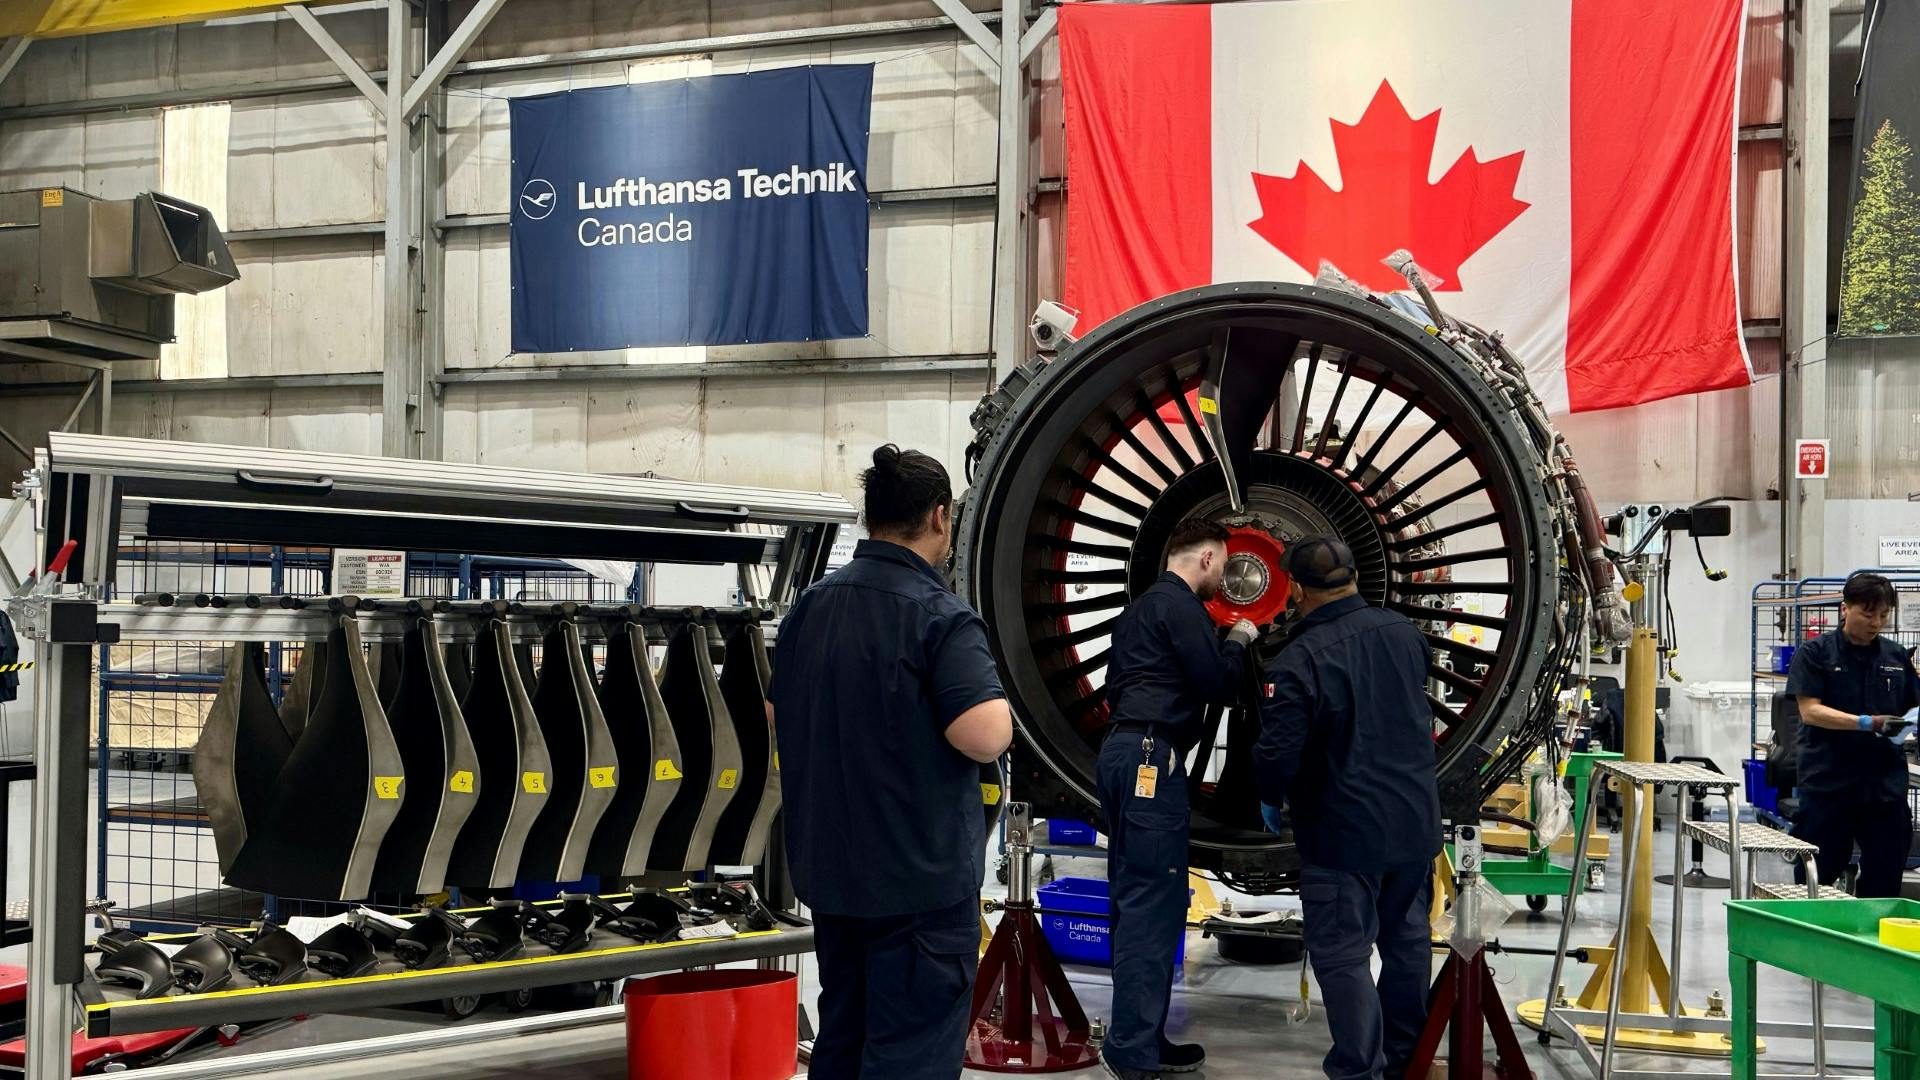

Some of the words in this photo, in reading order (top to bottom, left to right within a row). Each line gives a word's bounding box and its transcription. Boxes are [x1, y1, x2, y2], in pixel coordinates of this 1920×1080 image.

[578, 177, 731, 210] Lufthansa
[737, 162, 857, 199] Technik
[577, 213, 692, 247] Canada
[382, 781, 390, 794] 3
[459, 777, 467, 788] 4
[532, 778, 539, 789] 5
[1069, 931, 1102, 942] Canada
